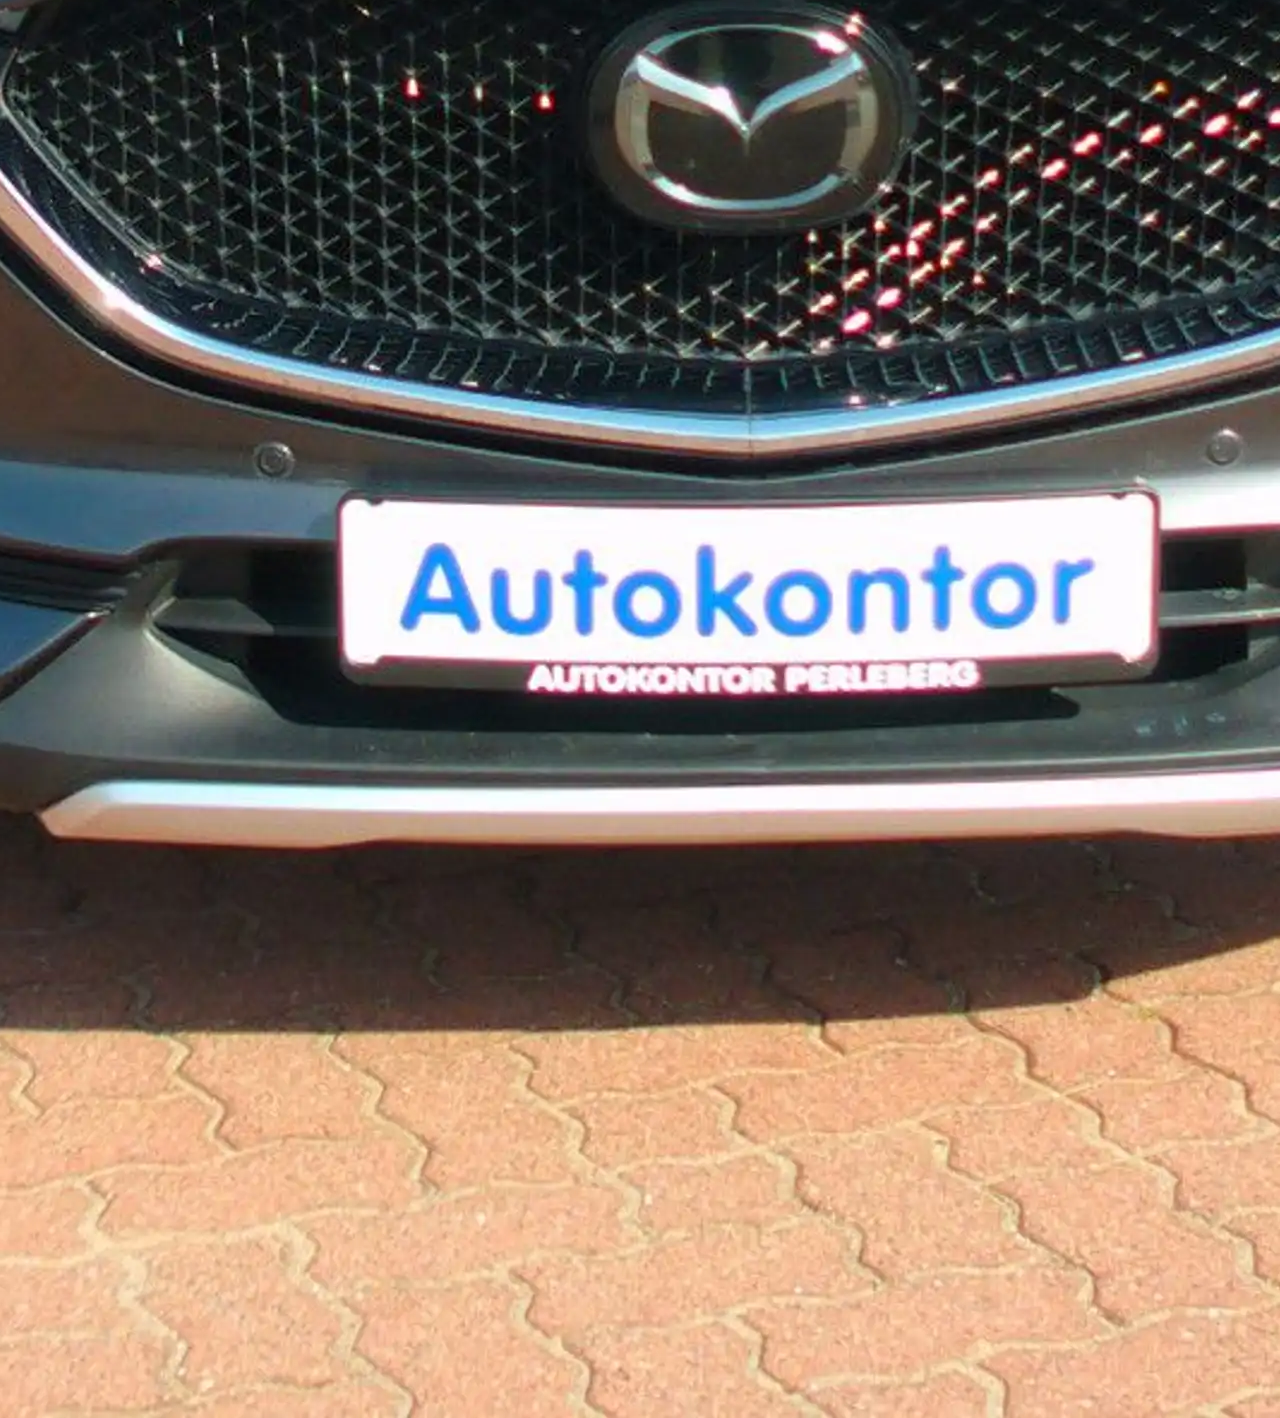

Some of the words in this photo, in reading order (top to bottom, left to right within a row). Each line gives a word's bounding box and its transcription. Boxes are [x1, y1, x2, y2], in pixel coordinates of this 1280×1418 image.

[400, 543, 1094, 639] Autokontor
[527, 663, 776, 694] AUTOKONTOR
[784, 659, 980, 692] PERLEBERG
